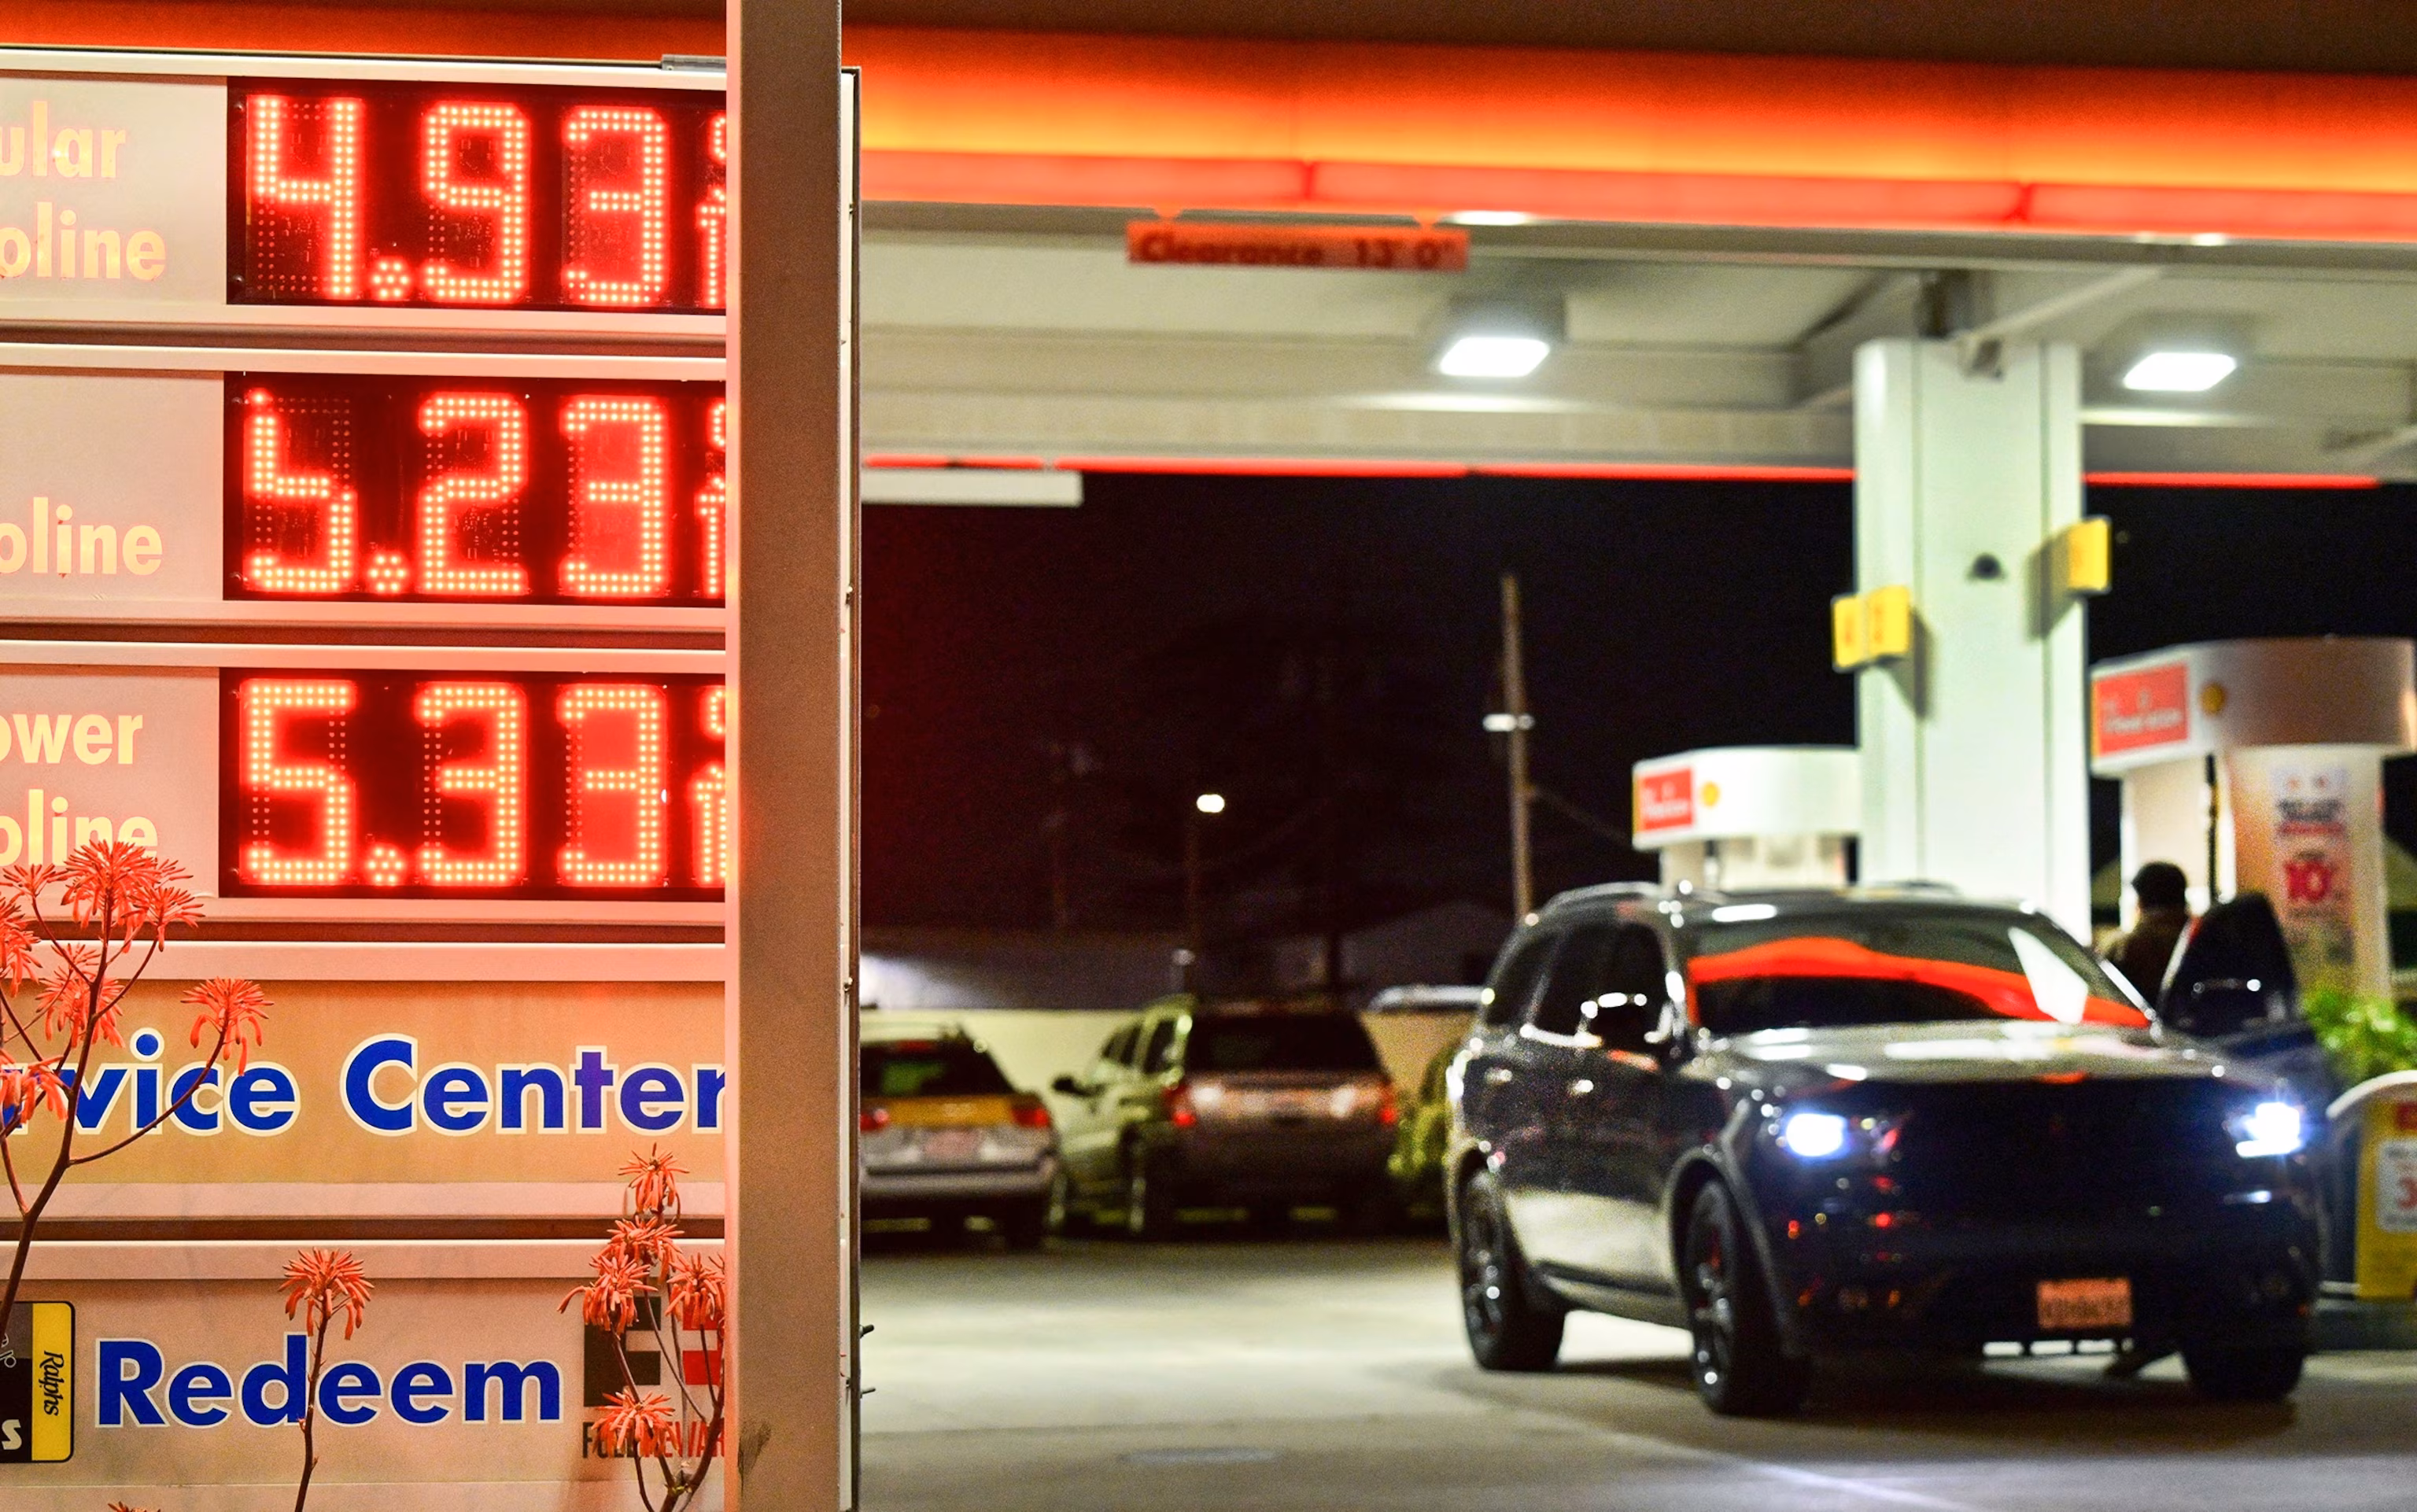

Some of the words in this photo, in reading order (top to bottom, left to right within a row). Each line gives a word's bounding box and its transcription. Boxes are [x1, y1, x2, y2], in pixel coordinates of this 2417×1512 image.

[0, 100, 127, 178] ular
[0, 201, 167, 280] oline
[0, 496, 163, 576] oline
[341, 1034, 725, 1135] Center
[38, 1350, 65, 1416] Ralphs
[95, 1332, 563, 1428] Redeem
